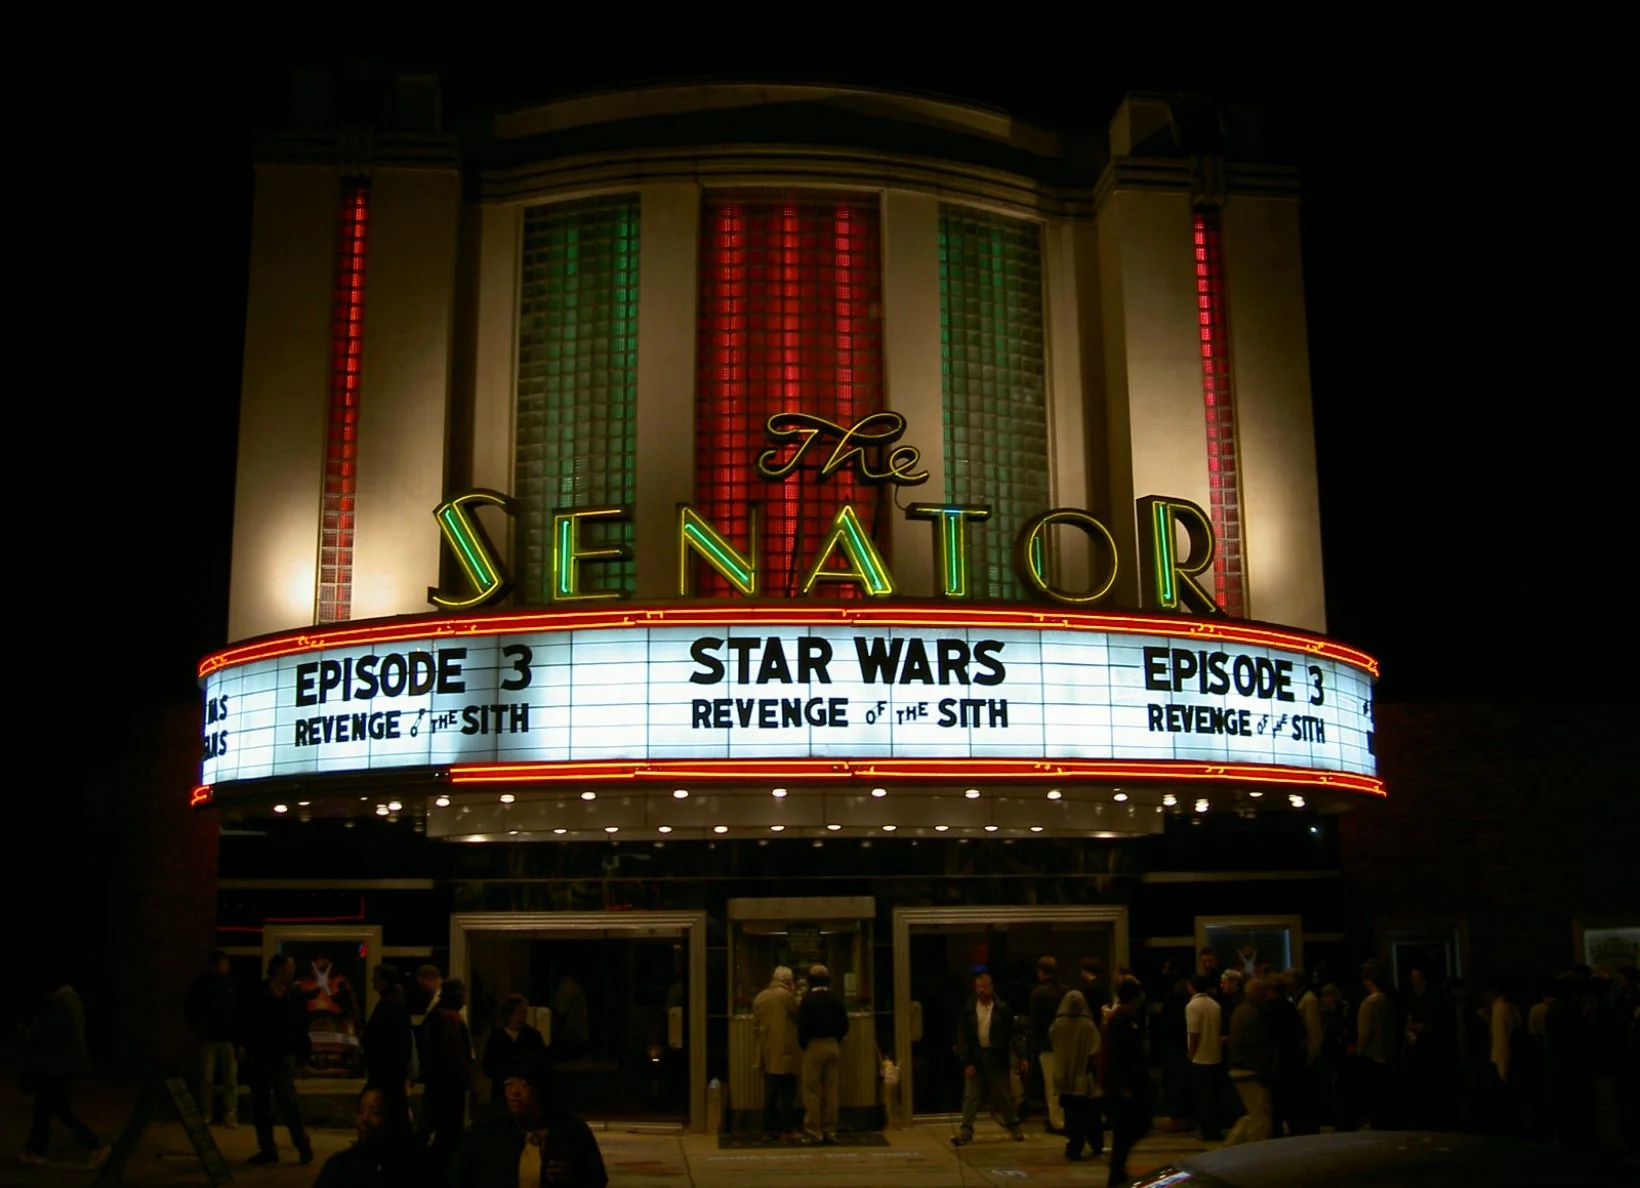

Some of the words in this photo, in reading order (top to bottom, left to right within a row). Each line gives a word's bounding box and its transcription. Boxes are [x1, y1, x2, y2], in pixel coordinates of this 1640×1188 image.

[756, 410, 929, 485] The
[427, 488, 1222, 614] SENATOR
[295, 647, 467, 708] EPISODE
[501, 644, 533, 691] 3
[689, 637, 833, 685] STAR
[854, 637, 1006, 687] WARS
[1143, 646, 1295, 702] EPISODE
[1309, 665, 1325, 706] 3
[295, 711, 401, 747] REVENGE
[431, 710, 458, 734] THE
[460, 703, 529, 735] SITH
[692, 697, 849, 729] REVENGE
[866, 701, 888, 725] OF
[896, 702, 929, 725] THE
[937, 698, 1009, 729] SITH
[1147, 703, 1252, 737] REVENGE
[1292, 714, 1325, 744] SITH
